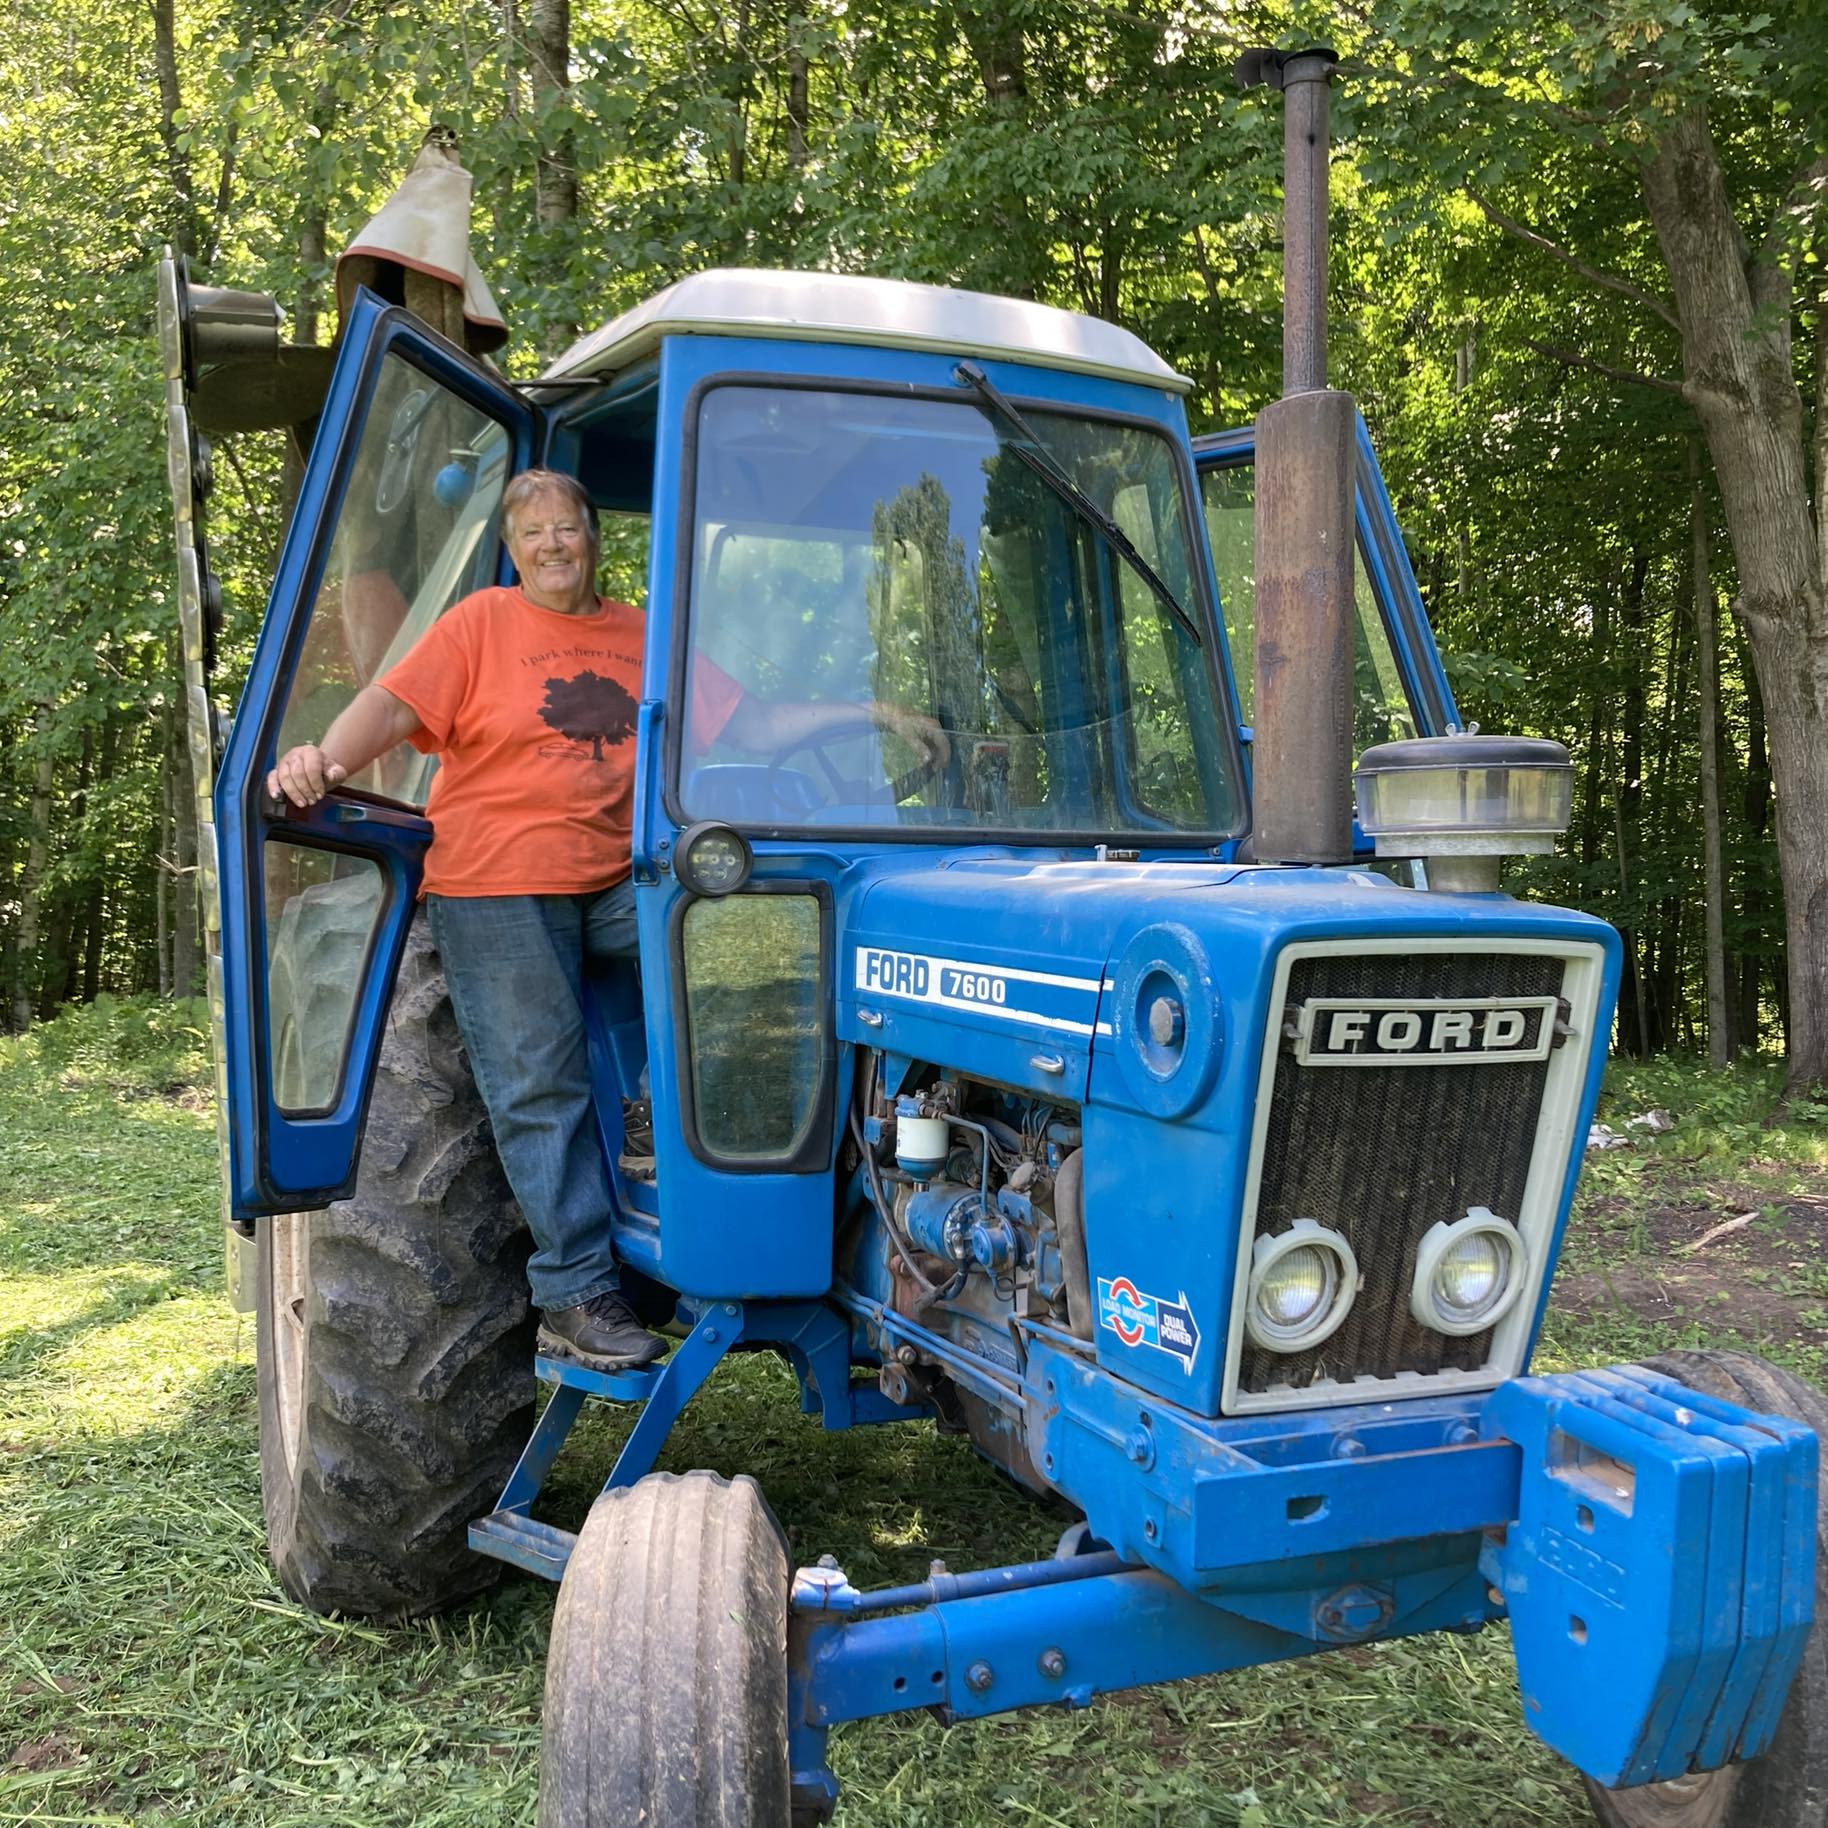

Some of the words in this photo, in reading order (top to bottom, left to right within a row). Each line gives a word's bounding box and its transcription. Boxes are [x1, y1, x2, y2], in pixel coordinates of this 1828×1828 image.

[529, 650, 560, 667] park
[562, 647, 604, 658] where
[607, 649, 612, 658] I
[866, 951, 929, 997] FORD
[949, 972, 1006, 1004] 7600
[1327, 1010, 1526, 1050] FORD
[1102, 1298, 1121, 1315] LOAD
[1163, 1313, 1187, 1331] DUAL
[1160, 1324, 1193, 1347] POWER
